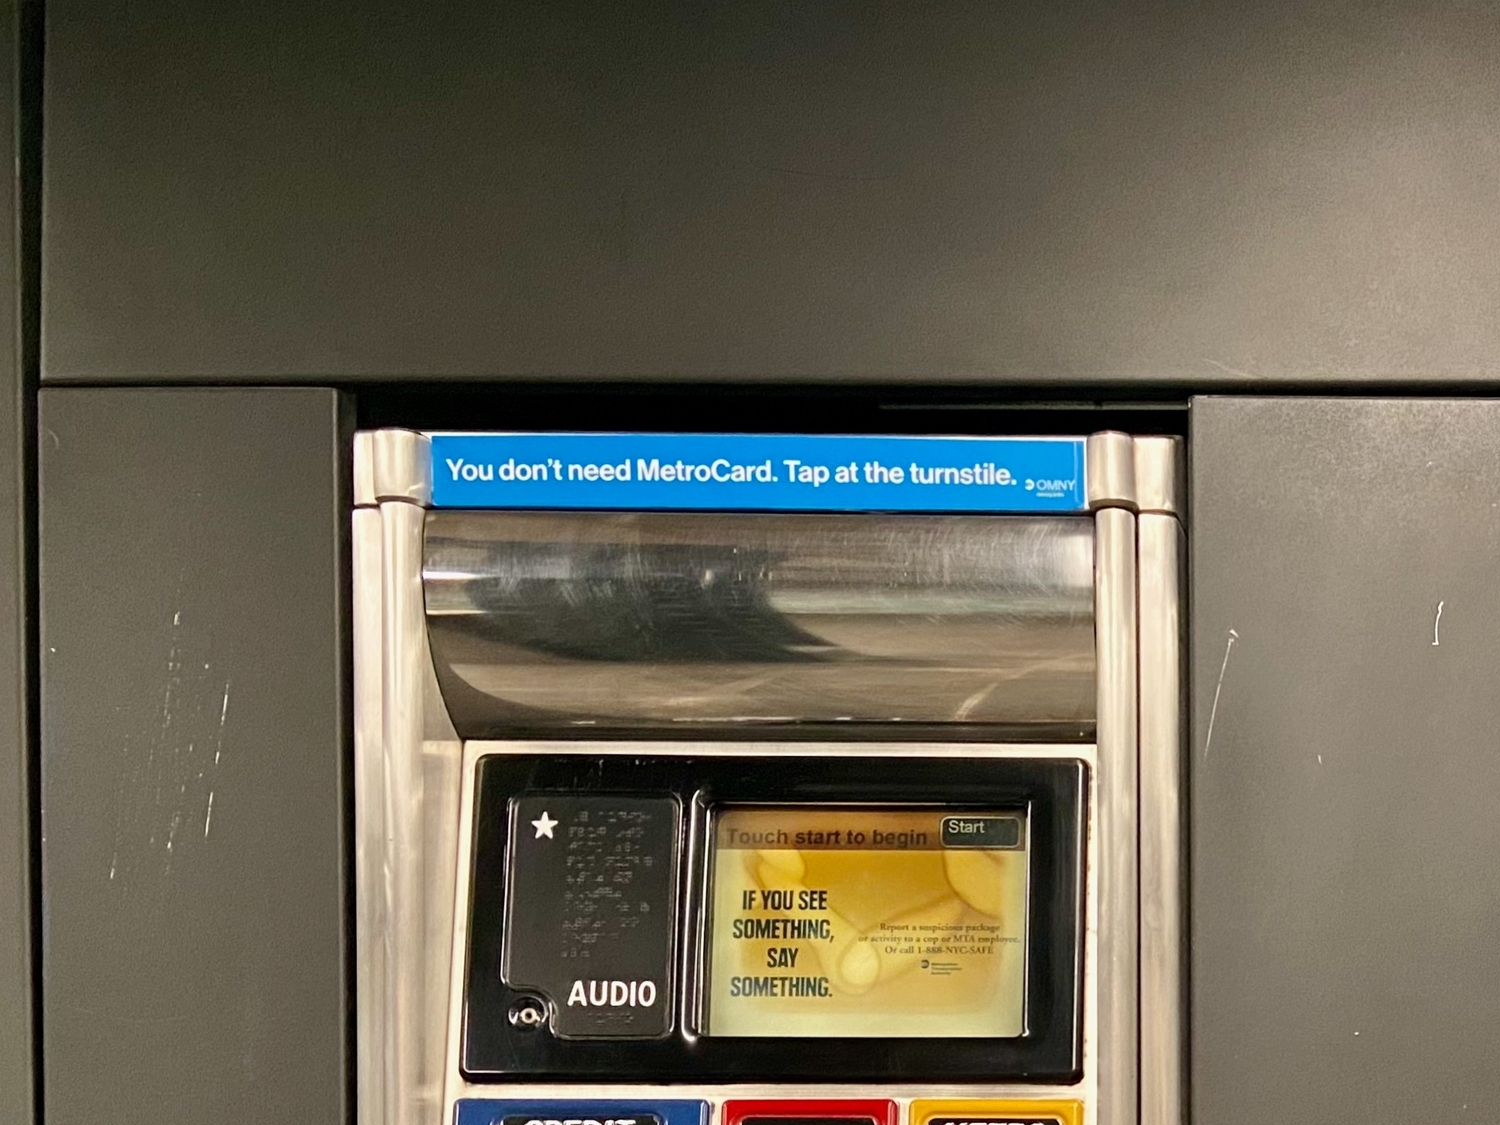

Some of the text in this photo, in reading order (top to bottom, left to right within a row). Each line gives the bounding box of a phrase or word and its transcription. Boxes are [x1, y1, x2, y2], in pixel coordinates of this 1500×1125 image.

[446, 458, 1017, 488] You don't need MetroCard. Tap at the turnstile.
[1036, 479, 1075, 490] OMNY
[948, 820, 984, 834] Start
[727, 829, 927, 848] Touch start to begin
[743, 890, 827, 910] IF YOU SEE
[733, 919, 834, 943] SOMETHING,
[880, 922, 909, 933] Report
[919, 922, 963, 933] suspicious
[966, 922, 1000, 934] package
[871, 935, 901, 945] activity
[924, 936, 937, 945] cop
[885, 945, 994, 954] Or call 1-888-NYC-SAFE
[767, 948, 798, 968] SAY
[567, 980, 656, 1008] AUDIO
[731, 977, 833, 997] SOMETHING.
